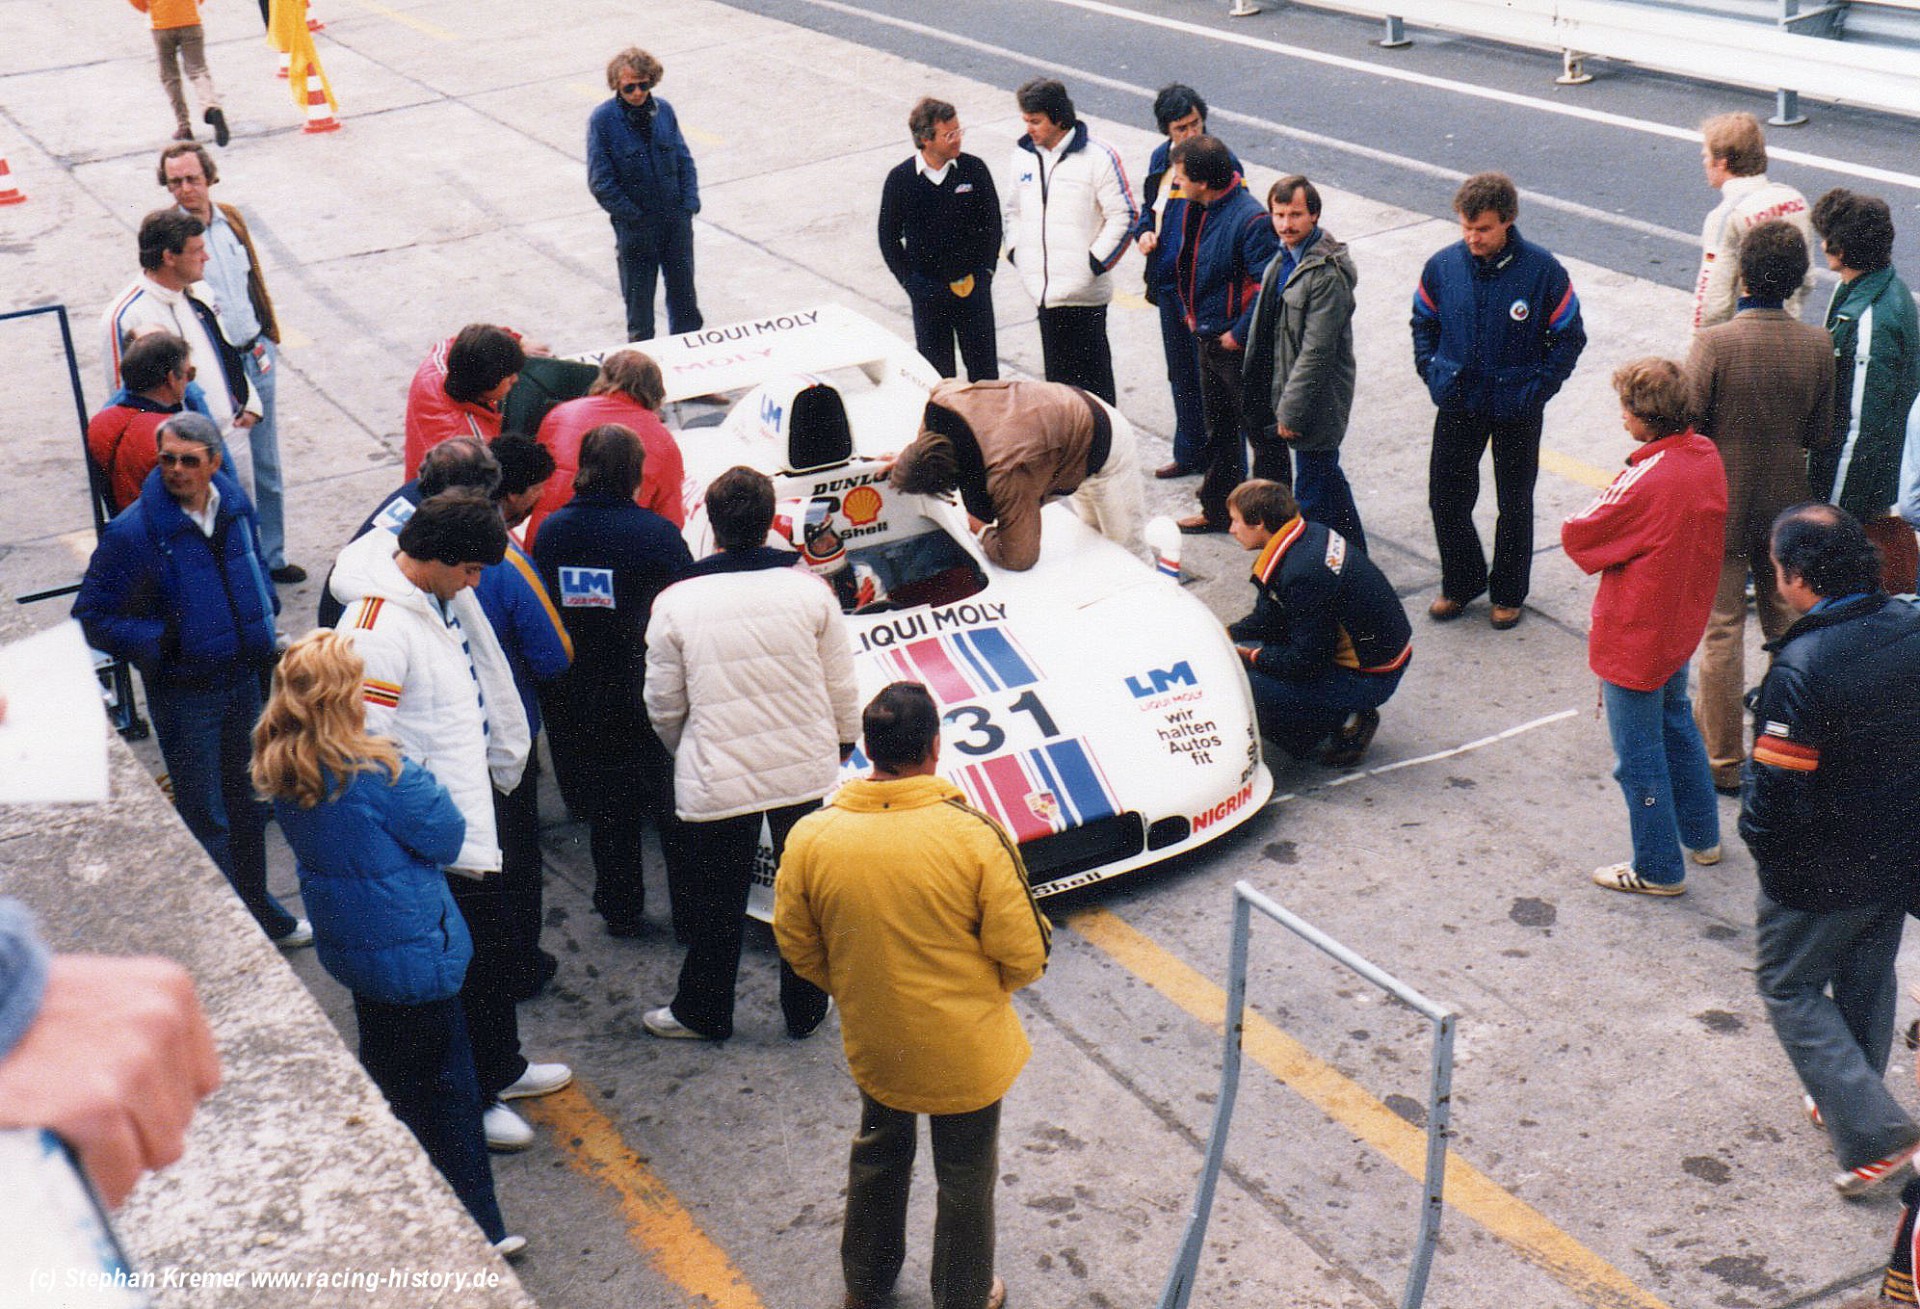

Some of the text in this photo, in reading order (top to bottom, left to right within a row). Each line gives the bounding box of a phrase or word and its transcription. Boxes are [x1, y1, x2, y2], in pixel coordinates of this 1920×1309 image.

[683, 310, 818, 348] LIQUI MOLY
[672, 347, 772, 374] MOLY
[811, 470, 894, 496] DUNLO
[841, 521, 889, 540] Shell
[563, 570, 611, 594] LM
[854, 603, 1007, 656] IQUI MOLY
[1125, 660, 1198, 699] LM
[1172, 690, 1203, 702] MOLY
[943, 690, 1060, 756] 31
[1164, 707, 1193, 724] wir
[1156, 720, 1217, 741] halten
[1169, 735, 1222, 755] Autos
[1191, 751, 1214, 766] fit
[1192, 782, 1254, 834] NIGRIN
[1032, 872, 1102, 897] Shell
